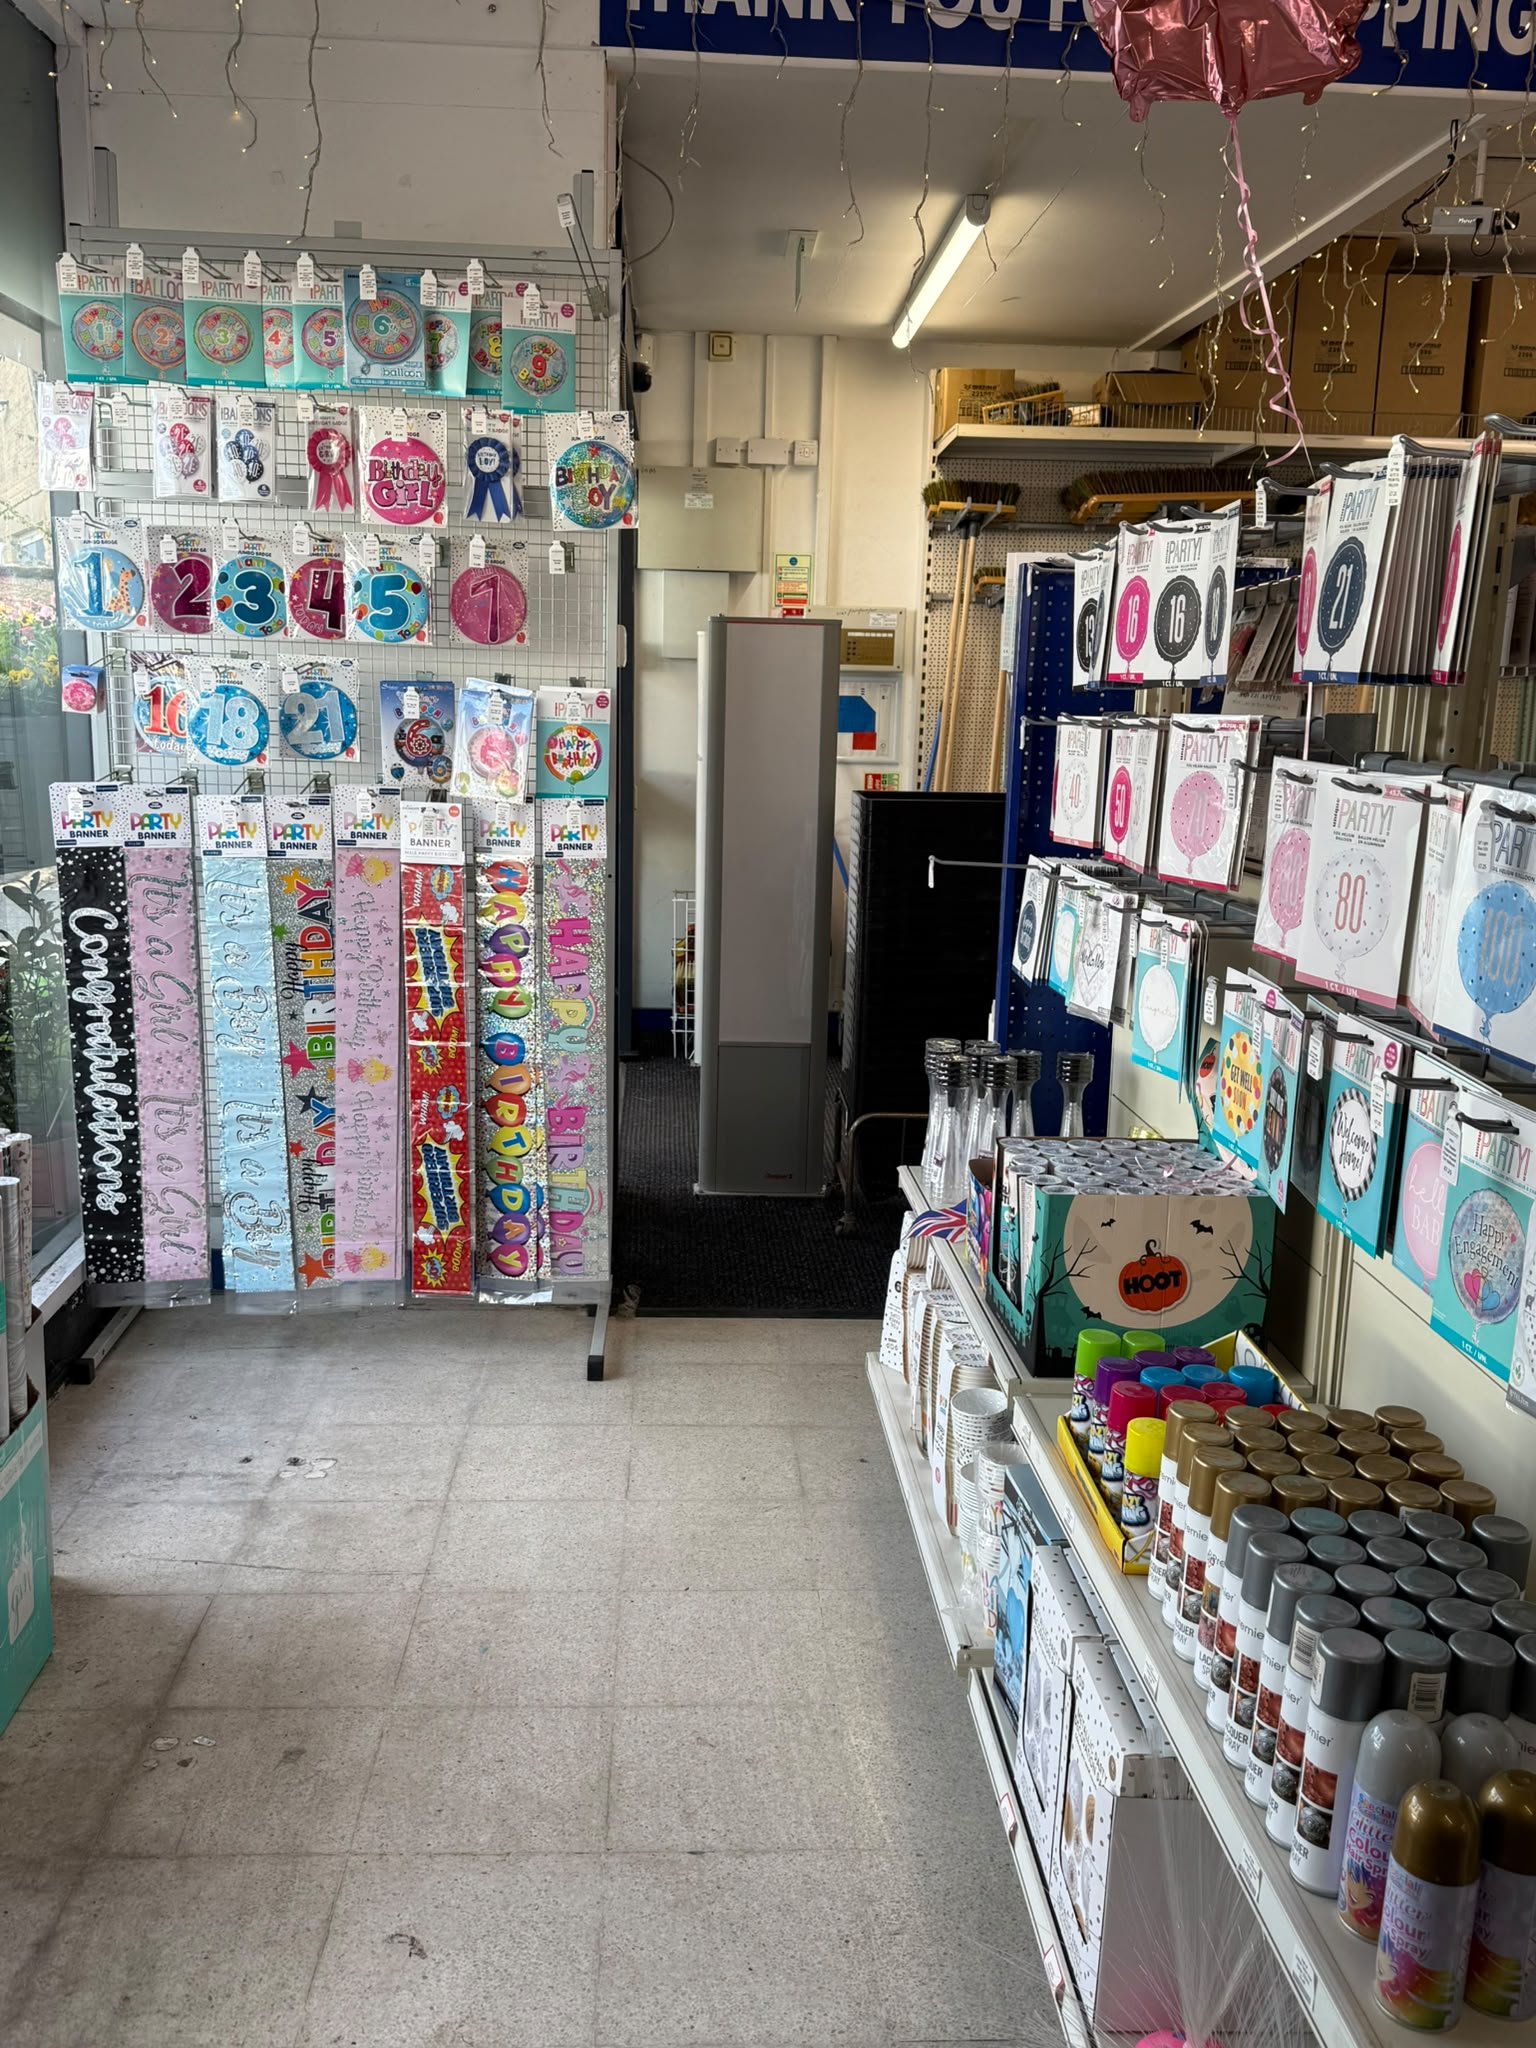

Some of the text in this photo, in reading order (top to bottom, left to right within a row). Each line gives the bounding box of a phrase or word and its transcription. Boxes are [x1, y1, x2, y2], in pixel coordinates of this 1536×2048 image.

[383, 367, 423, 379] balloon
[531, 353, 547, 379] 9
[1166, 537, 1203, 564] PARTY!
[172, 557, 213, 619] 2
[233, 569, 278, 625] 3
[308, 568, 346, 632] 4
[367, 572, 411, 632] 5
[1329, 563, 1353, 630] 21
[1126, 594, 1140, 644] 16
[1168, 594, 1187, 644] 16
[200, 692, 260, 750] 18
[289, 689, 346, 746] 21
[406, 718, 433, 757] 6
[1182, 734, 1229, 763] PARTY!
[1069, 774, 1081, 809] 40
[130, 811, 183, 831] PARTY
[1115, 784, 1126, 841] 50
[1338, 798, 1394, 836] PARTY!
[69, 830, 109, 839] BANNER
[137, 831, 177, 840] BANNER
[215, 840, 253, 850] BANNER
[272, 823, 325, 841] PARTY
[279, 841, 318, 851] BANNER
[350, 831, 388, 841] BANNER
[410, 838, 451, 848] BANNER
[486, 838, 521, 848] BANNER
[557, 842, 593, 851] BANNER
[1334, 871, 1366, 934] 80
[490, 863, 528, 1010] HAPPY
[1477, 908, 1525, 987] 100
[296, 880, 336, 1062] BIRTHDAY
[69, 907, 135, 1216] Congratulations
[1230, 1064, 1253, 1092] GET WELL
[418, 1090, 431, 1127] WHAM!
[1233, 1090, 1247, 1111] SOON
[1335, 1108, 1371, 1155] Welcome
[494, 1039, 528, 1270] BIRTHDAY
[1477, 1131, 1531, 1182] PARTY!
[1473, 1212, 1509, 1252] Happy
[1453, 1234, 1521, 1289] Engagement
[1122, 1269, 1184, 1296] HOOT
[1390, 1931, 1428, 1961] Spray
